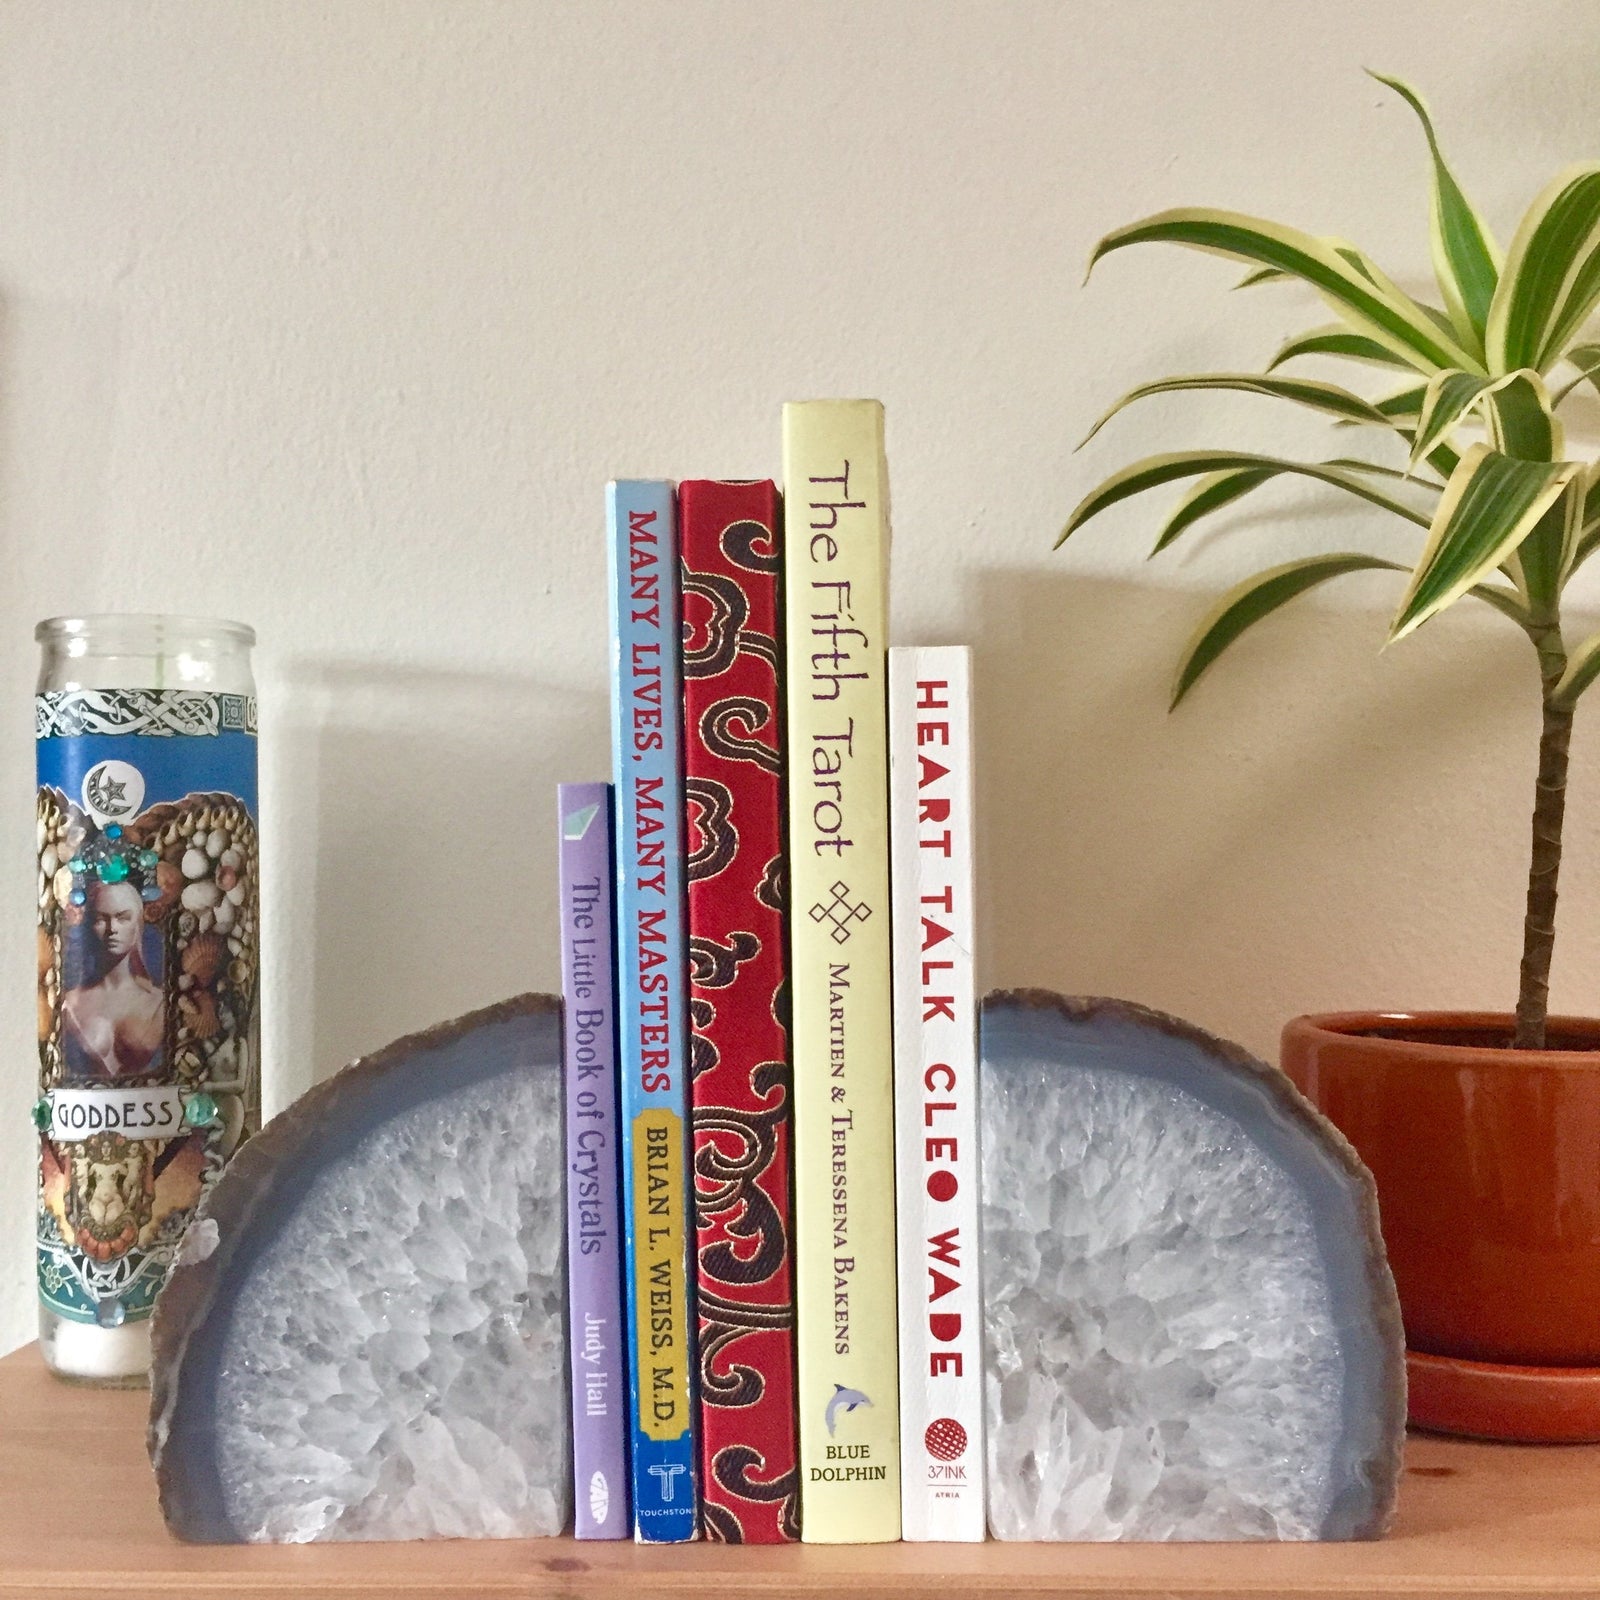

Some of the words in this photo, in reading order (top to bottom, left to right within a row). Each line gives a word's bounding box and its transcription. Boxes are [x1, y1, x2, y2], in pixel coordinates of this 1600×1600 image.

[809, 459, 866, 563] The
[628, 510, 660, 629] MANY
[810, 580, 869, 701] Fifth
[631, 642, 663, 762] LIVES,
[811, 716, 855, 857] Tarot
[916, 680, 951, 858] HEART
[634, 776, 667, 896] MANY
[572, 876, 600, 929] The
[573, 938, 597, 999] Little
[920, 886, 955, 1022] TALK
[575, 1008, 605, 1082] Book
[638, 909, 671, 1093] MASTERS
[58, 1100, 174, 1129] GODDESS
[576, 1091, 605, 1119] of
[831, 1086, 847, 1103] &
[924, 1063, 959, 1202] CLEO
[573, 1130, 607, 1256] Crystals
[646, 1127, 670, 1216] BRIAN
[648, 1227, 670, 1251] L.
[580, 1311, 607, 1363] Judy
[649, 1259, 674, 1355] WEISS,
[927, 1227, 963, 1377] WADE
[585, 1371, 608, 1416] Hall
[652, 1365, 676, 1428] M.D.
[810, 1465, 887, 1481] DOLPHIN
[826, 1444, 871, 1460] BLUE
[640, 1508, 694, 1517] TOUCHSTON
